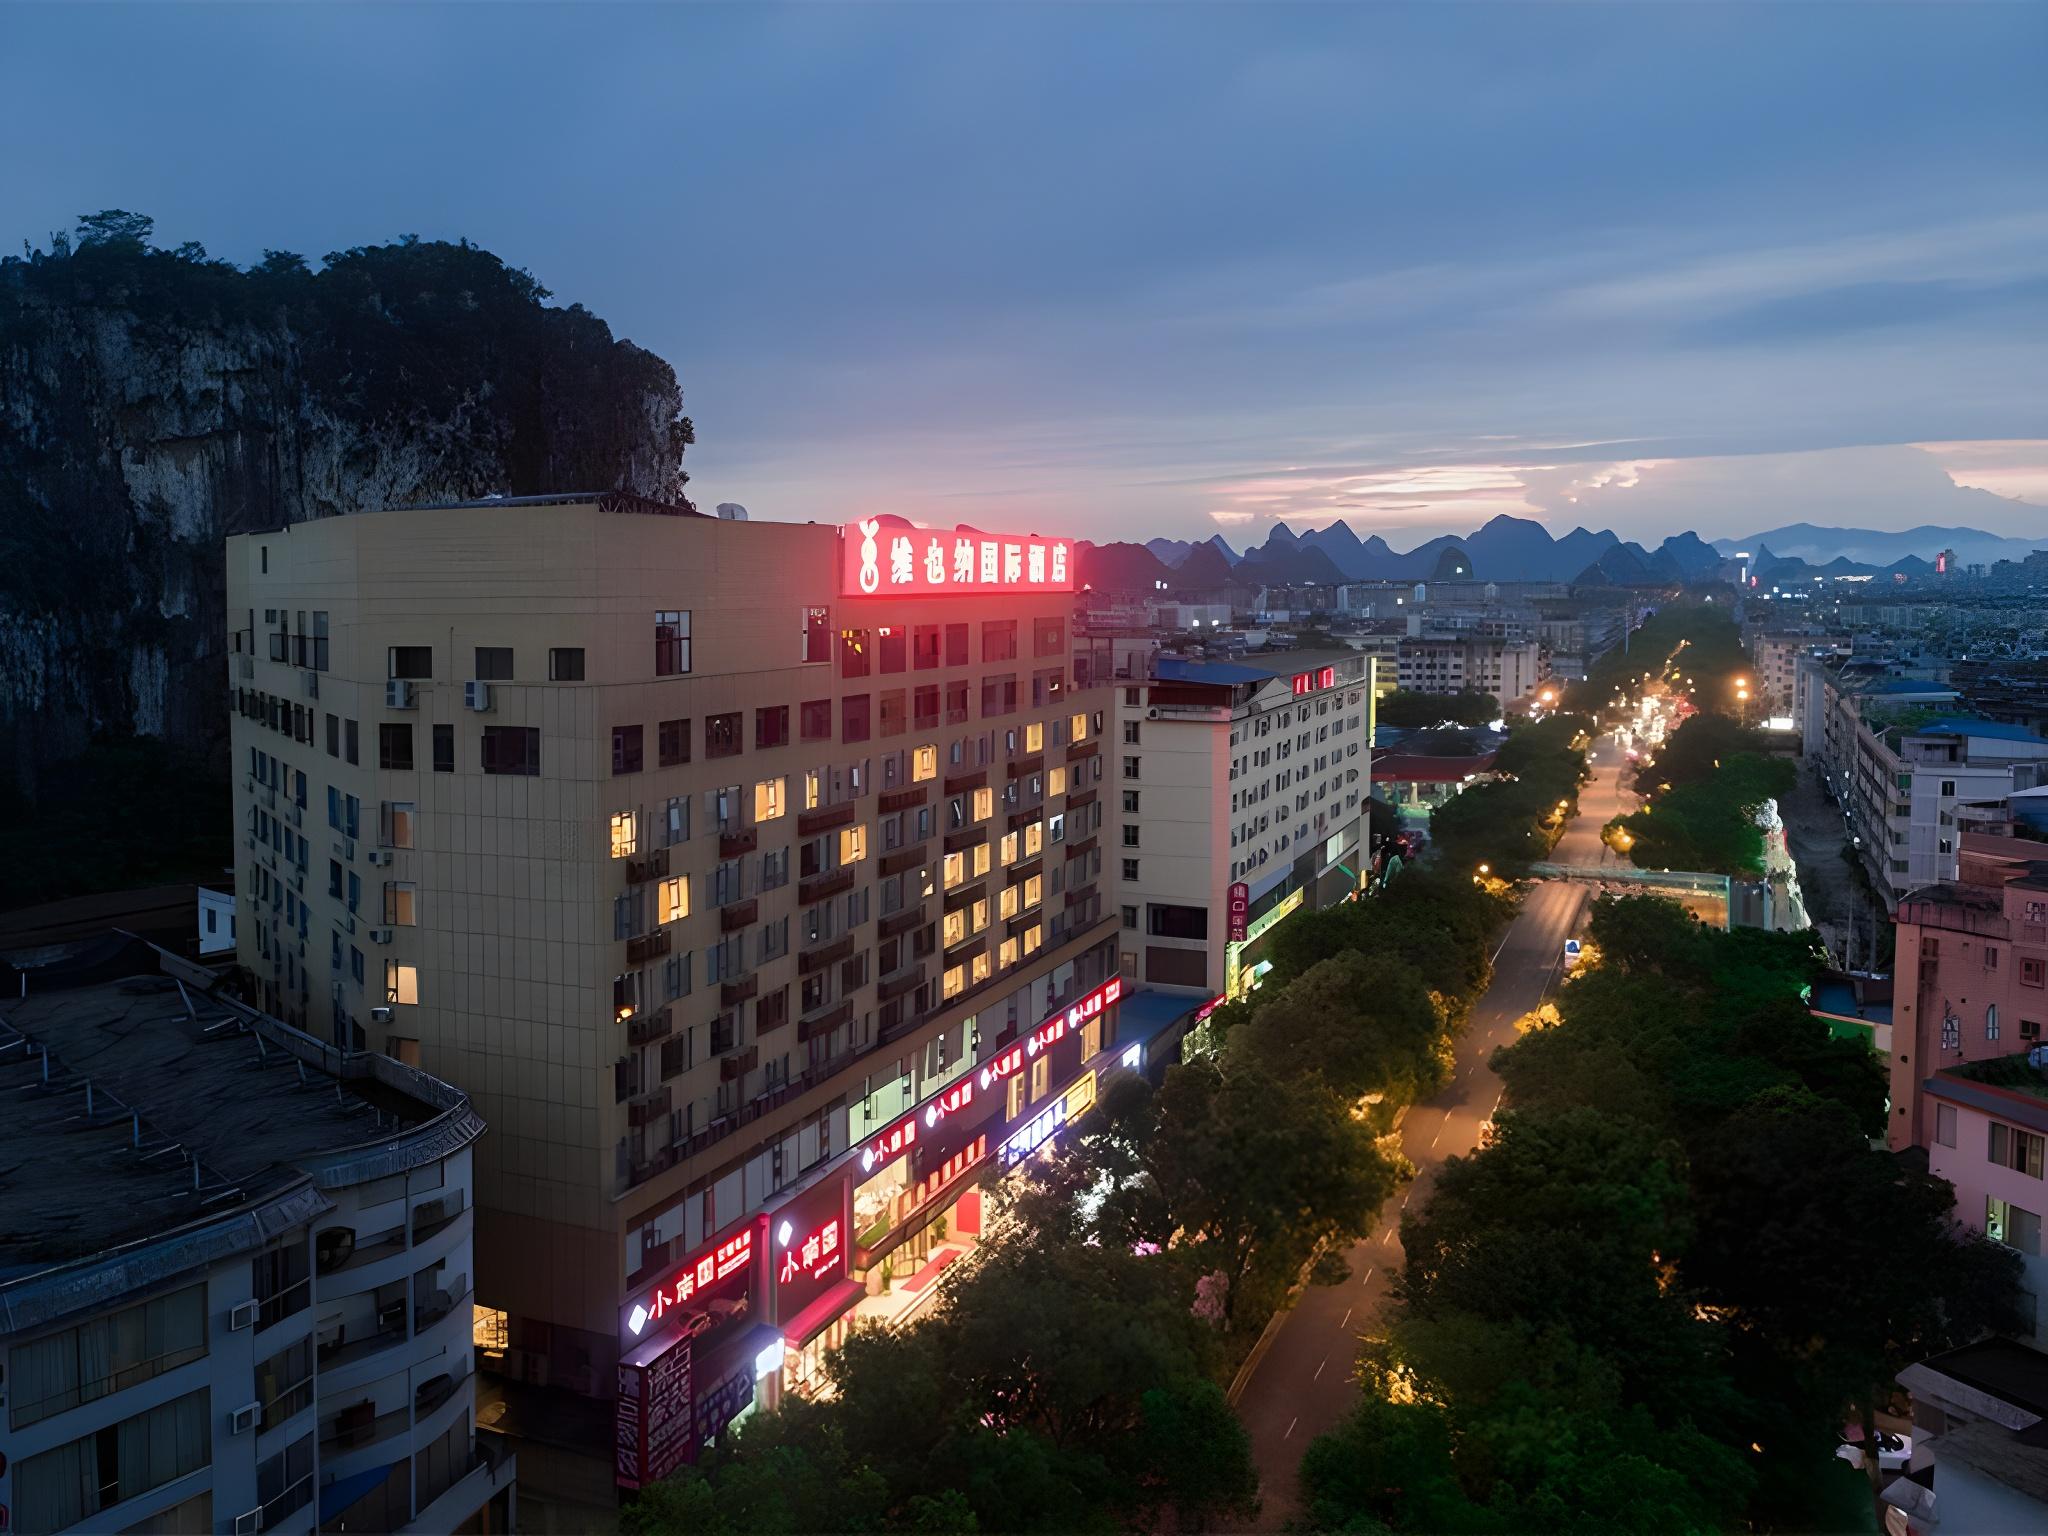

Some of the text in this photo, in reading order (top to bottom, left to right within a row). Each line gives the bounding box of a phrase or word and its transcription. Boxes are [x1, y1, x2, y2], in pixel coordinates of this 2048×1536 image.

[890, 536, 1067, 583] 维也纳国际酒店
